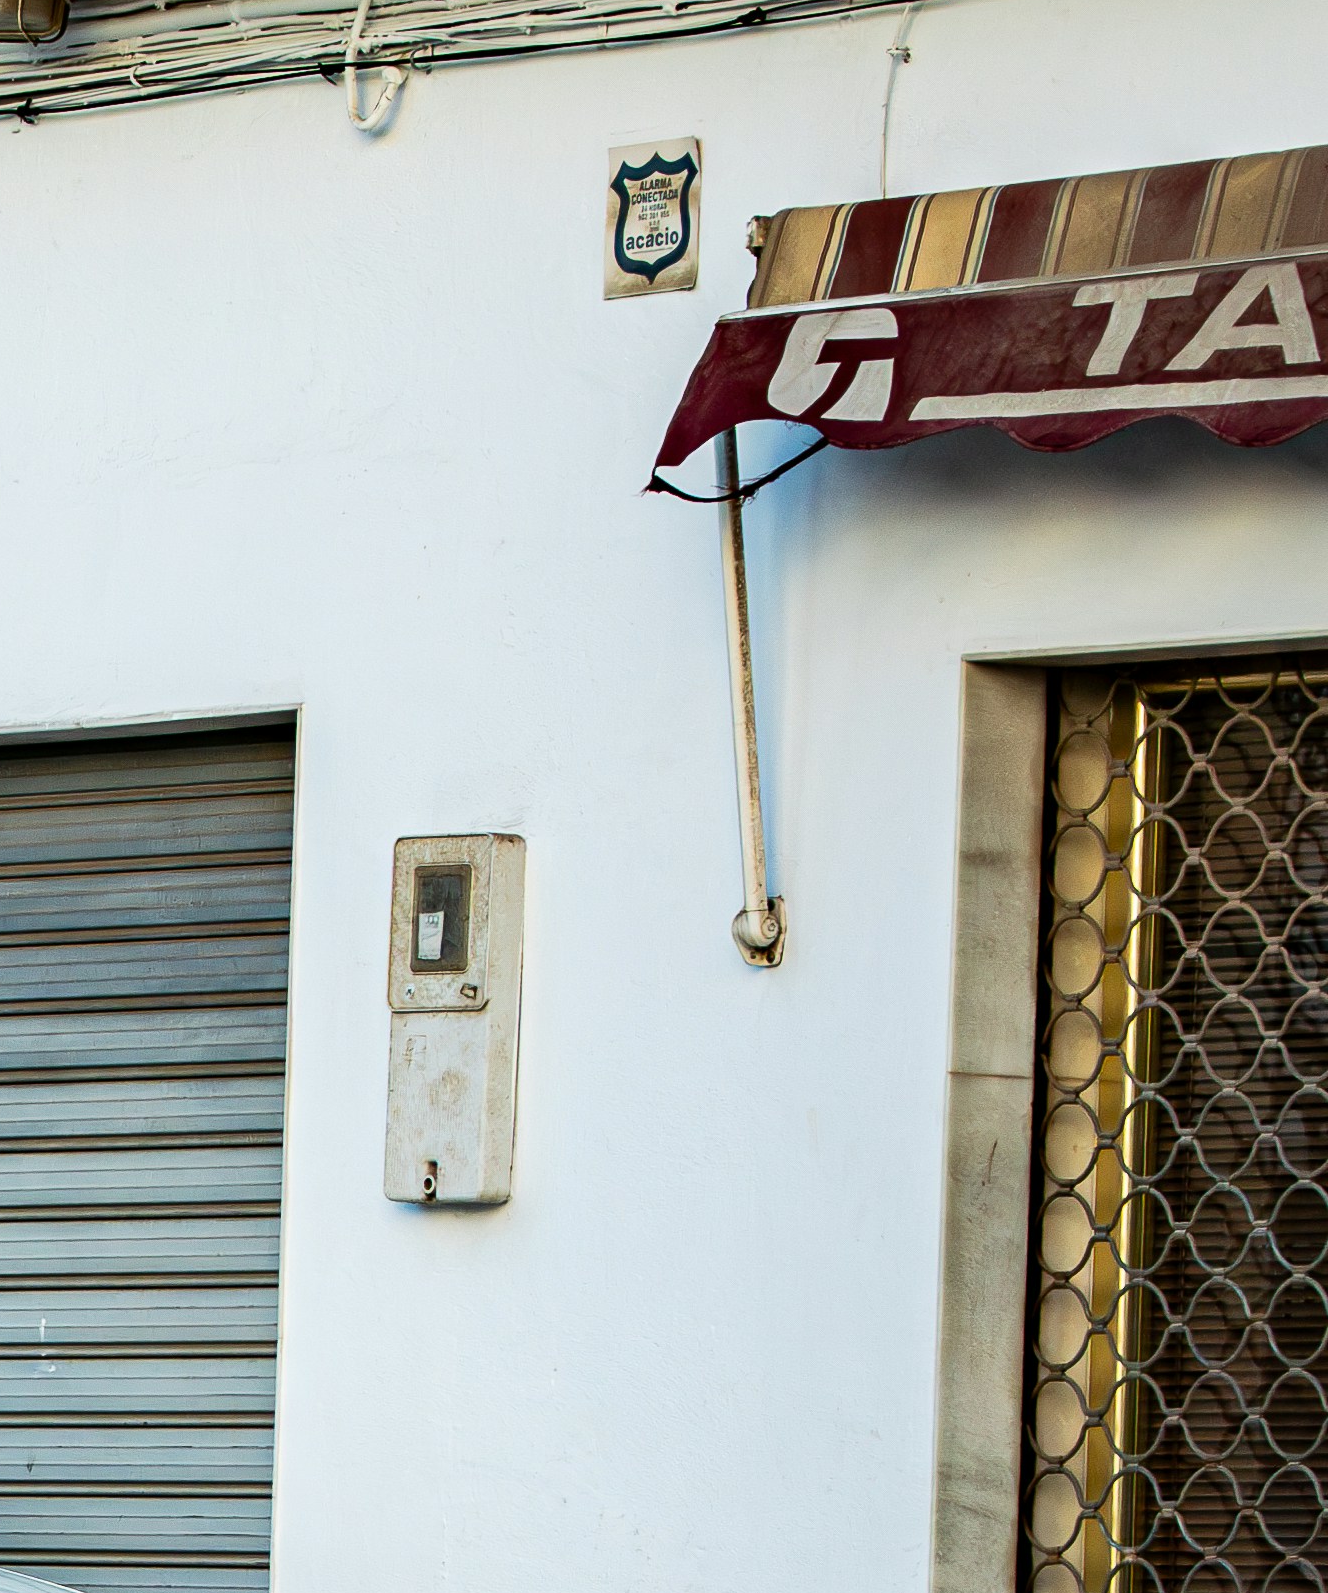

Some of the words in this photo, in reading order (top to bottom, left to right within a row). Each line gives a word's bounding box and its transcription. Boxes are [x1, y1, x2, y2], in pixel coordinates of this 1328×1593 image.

[639, 177, 673, 191] ALARMA
[631, 190, 679, 205] CONECTADA
[625, 227, 680, 250] acacio
